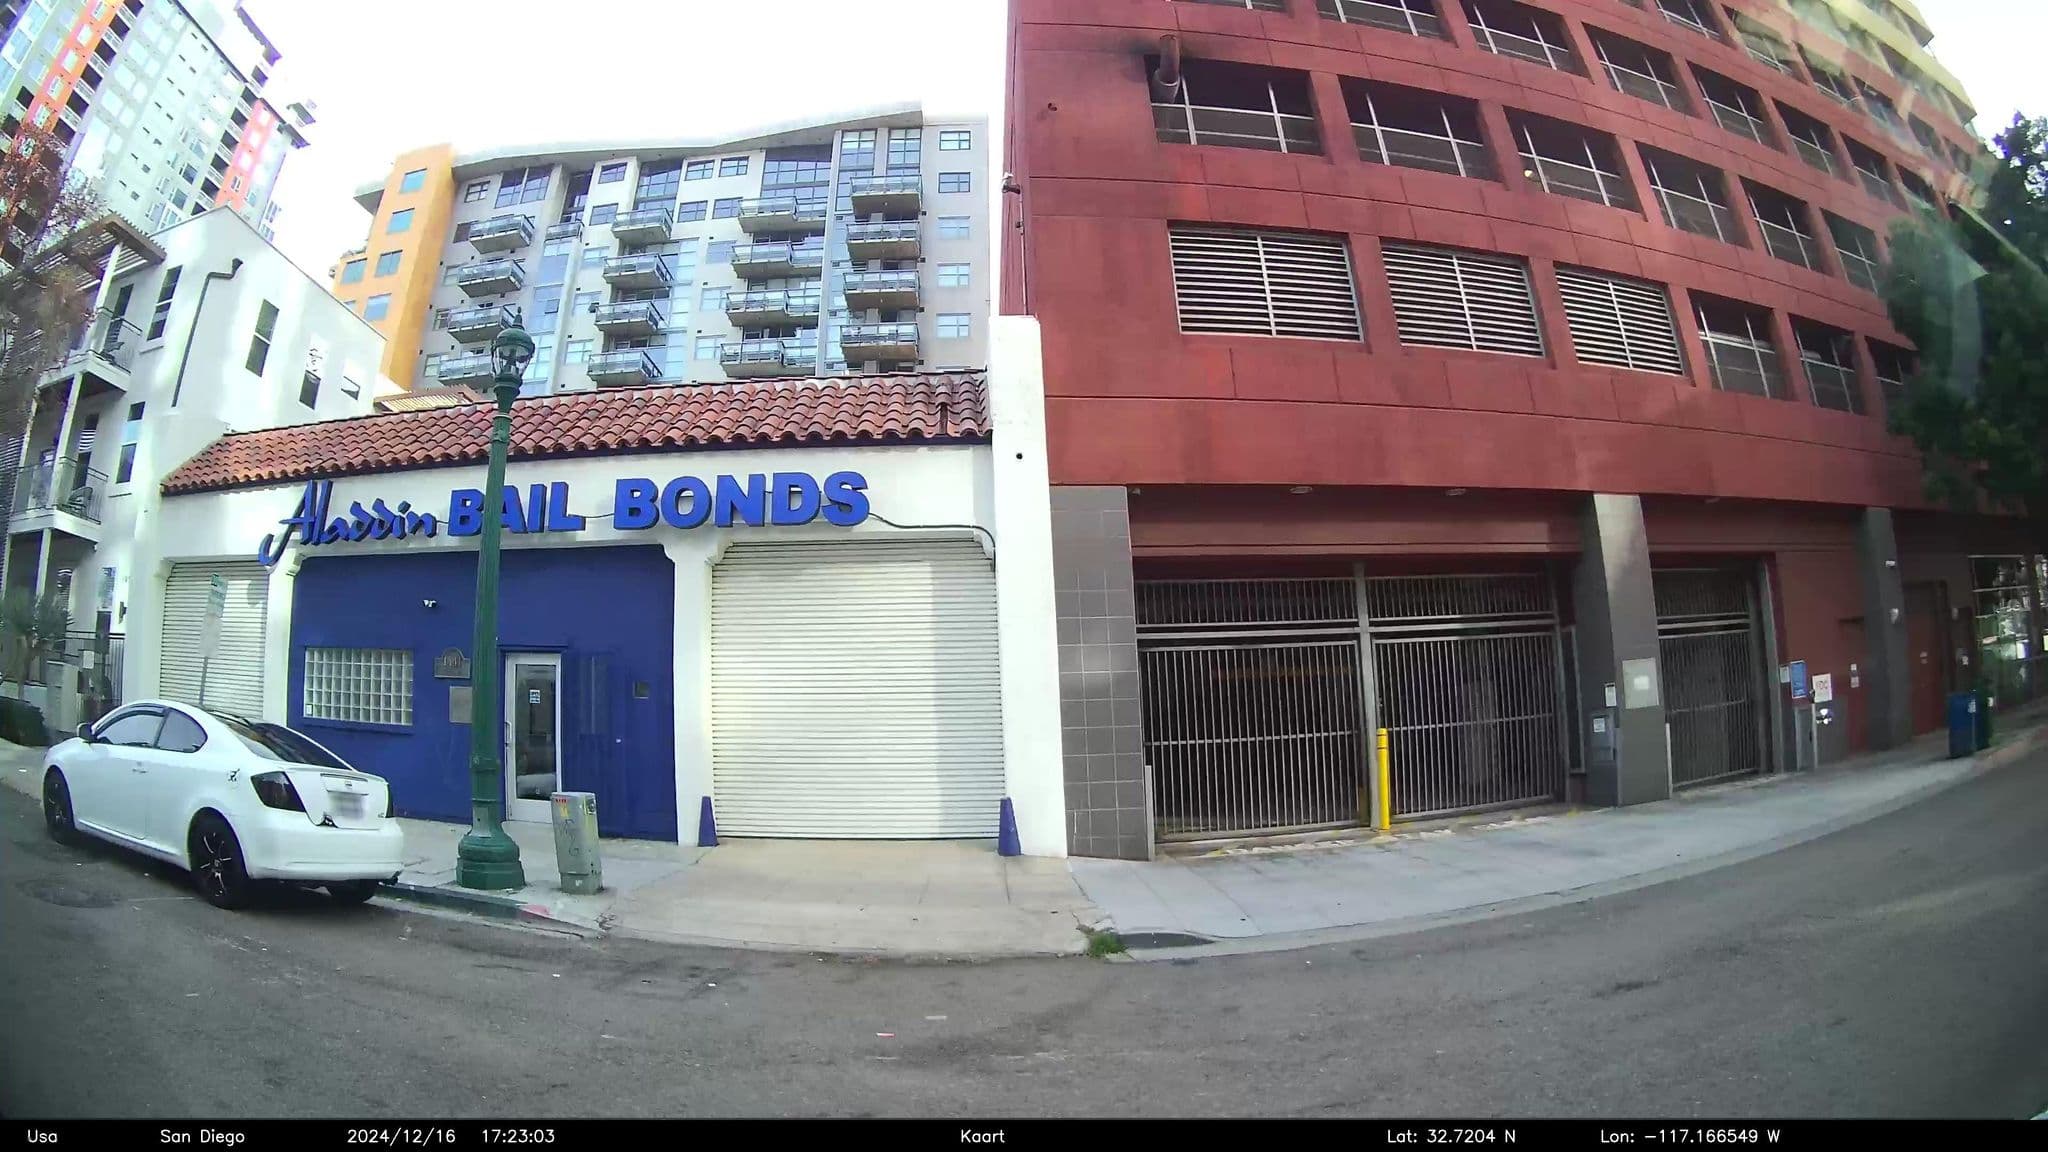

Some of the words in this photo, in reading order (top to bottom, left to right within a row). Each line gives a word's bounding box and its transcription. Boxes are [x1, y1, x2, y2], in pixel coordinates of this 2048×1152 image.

[257, 479, 438, 566] Aladdin
[447, 481, 586, 537] BAIL
[613, 470, 870, 530] BONDS
